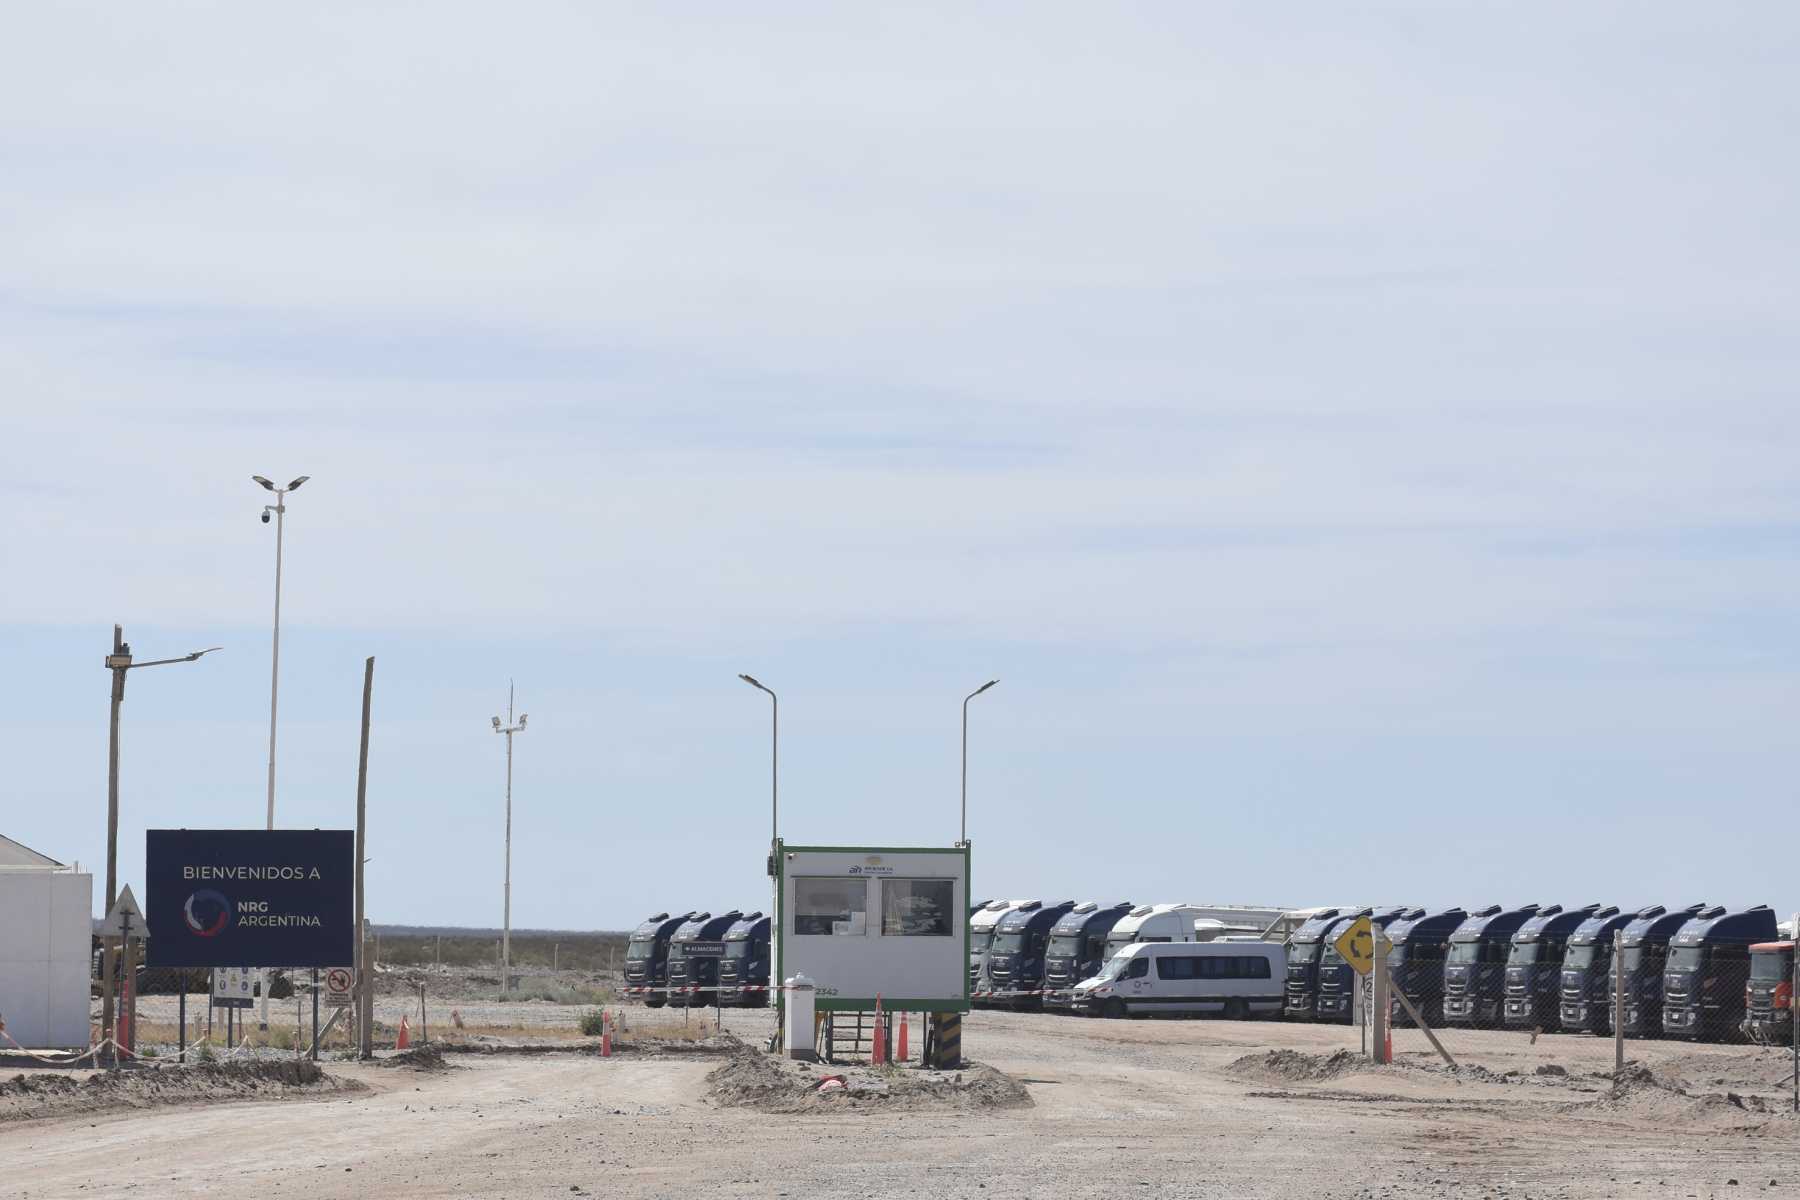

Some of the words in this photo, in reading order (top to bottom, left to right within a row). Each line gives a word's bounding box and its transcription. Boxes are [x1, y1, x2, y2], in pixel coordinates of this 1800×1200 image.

[183, 866, 304, 880] BIENVENIDOS
[308, 867, 321, 880] A
[237, 901, 268, 913] NRG
[238, 915, 321, 927] ARGENTINA
